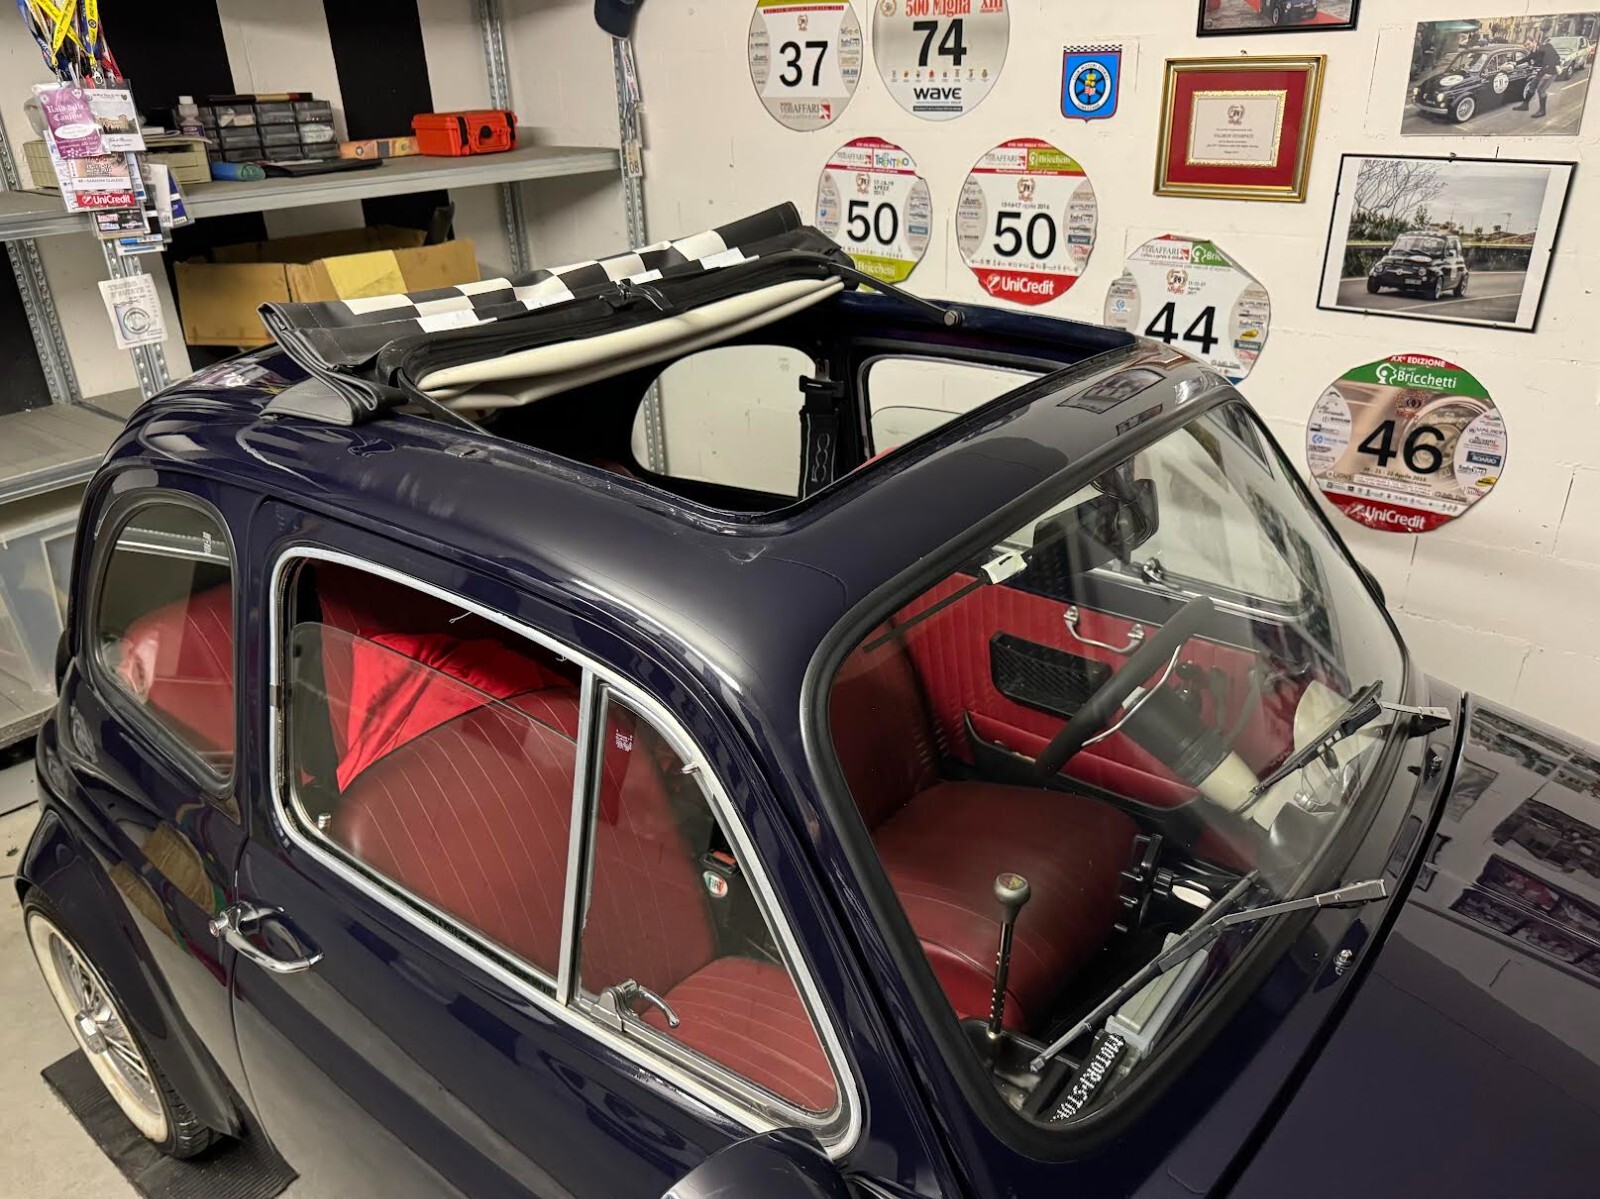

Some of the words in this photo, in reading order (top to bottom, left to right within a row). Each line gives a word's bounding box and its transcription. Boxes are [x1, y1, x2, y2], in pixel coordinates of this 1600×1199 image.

[912, 18, 967, 67] 74
[779, 40, 828, 87] 37
[913, 87, 962, 100] wave
[92, 194, 131, 204] UniCredit
[846, 200, 898, 245] 50
[993, 210, 1056, 260] 50
[1001, 276, 1055, 295] UniCredit
[1144, 302, 1219, 355] 44
[1397, 370, 1457, 389] Bricchetti
[1407, 357, 1446, 368] EDIZIONE
[1357, 420, 1446, 474] 46
[1366, 506, 1426, 529] UniCredit
